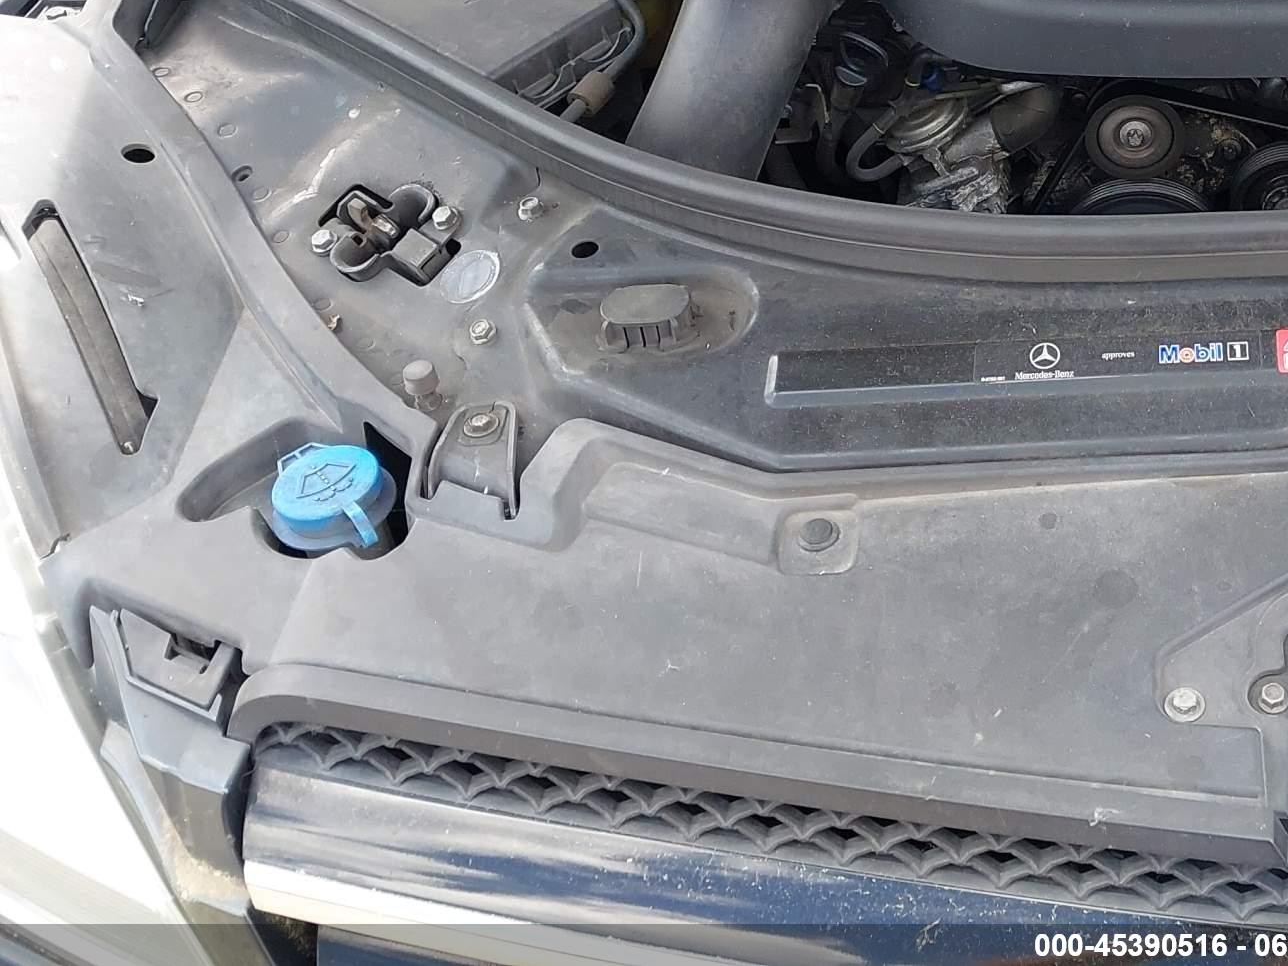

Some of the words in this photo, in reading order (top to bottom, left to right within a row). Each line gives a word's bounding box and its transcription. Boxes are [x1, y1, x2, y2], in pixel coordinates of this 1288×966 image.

[1101, 351, 1135, 360] approves
[1158, 342, 1223, 364] Mobil
[1014, 370, 1075, 380] Mercedes-Benz
